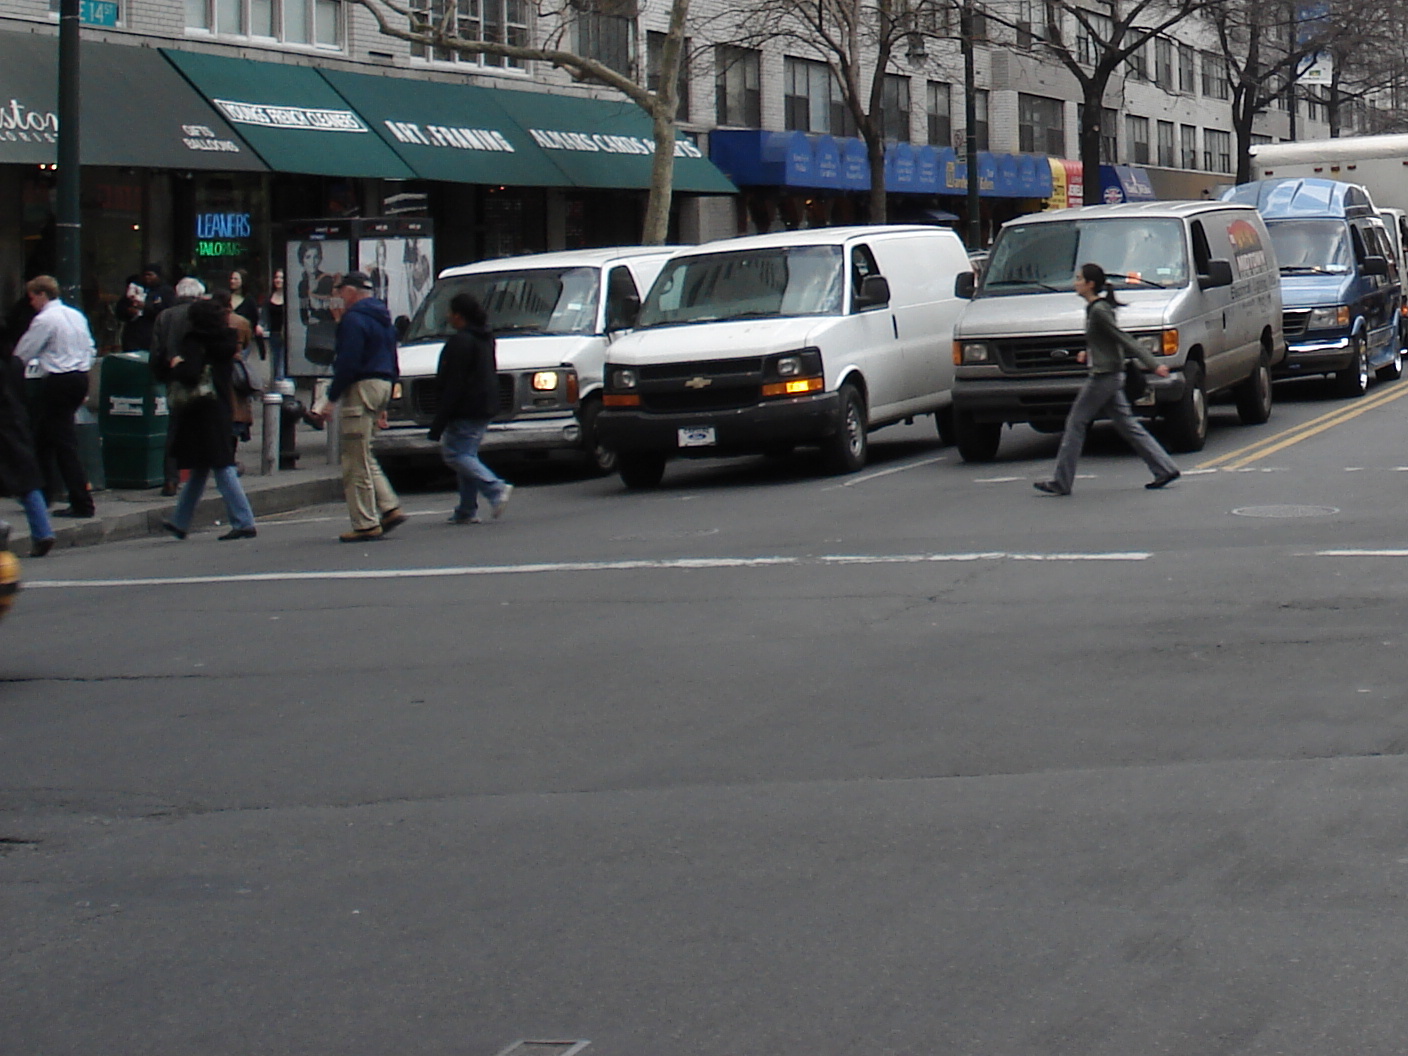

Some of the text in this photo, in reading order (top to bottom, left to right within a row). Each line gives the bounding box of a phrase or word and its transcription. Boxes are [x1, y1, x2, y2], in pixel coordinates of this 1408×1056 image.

[306, 112, 360, 129] CLEANERS
[182, 138, 240, 152] BALLOONS
[384, 120, 430, 145] ART
[427, 125, 515, 153] FRAMING
[592, 134, 650, 155] CARDS
